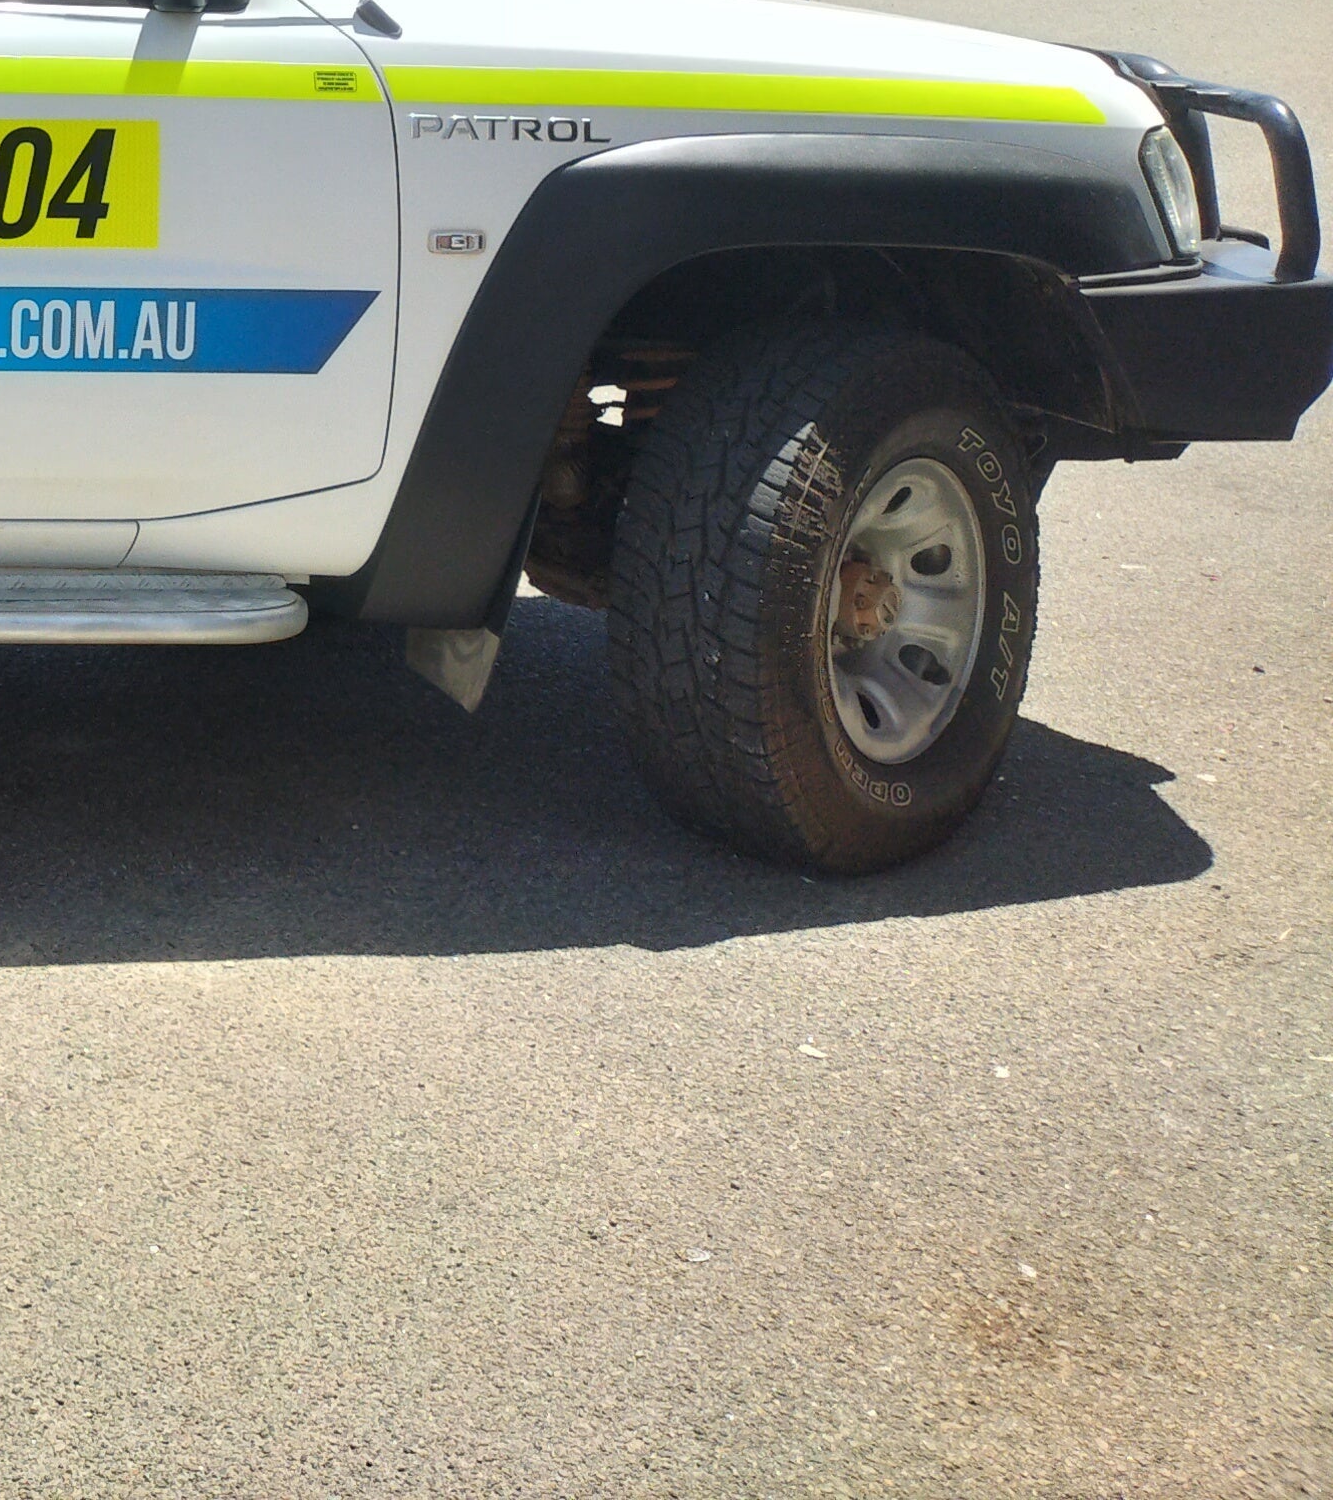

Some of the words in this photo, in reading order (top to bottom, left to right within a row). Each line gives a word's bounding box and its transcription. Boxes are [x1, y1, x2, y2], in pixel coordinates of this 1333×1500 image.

[407, 112, 612, 144] PATROL
[956, 425, 1024, 567] TOYO
[991, 591, 1023, 705] A/T
[834, 740, 914, 807] OPEN
